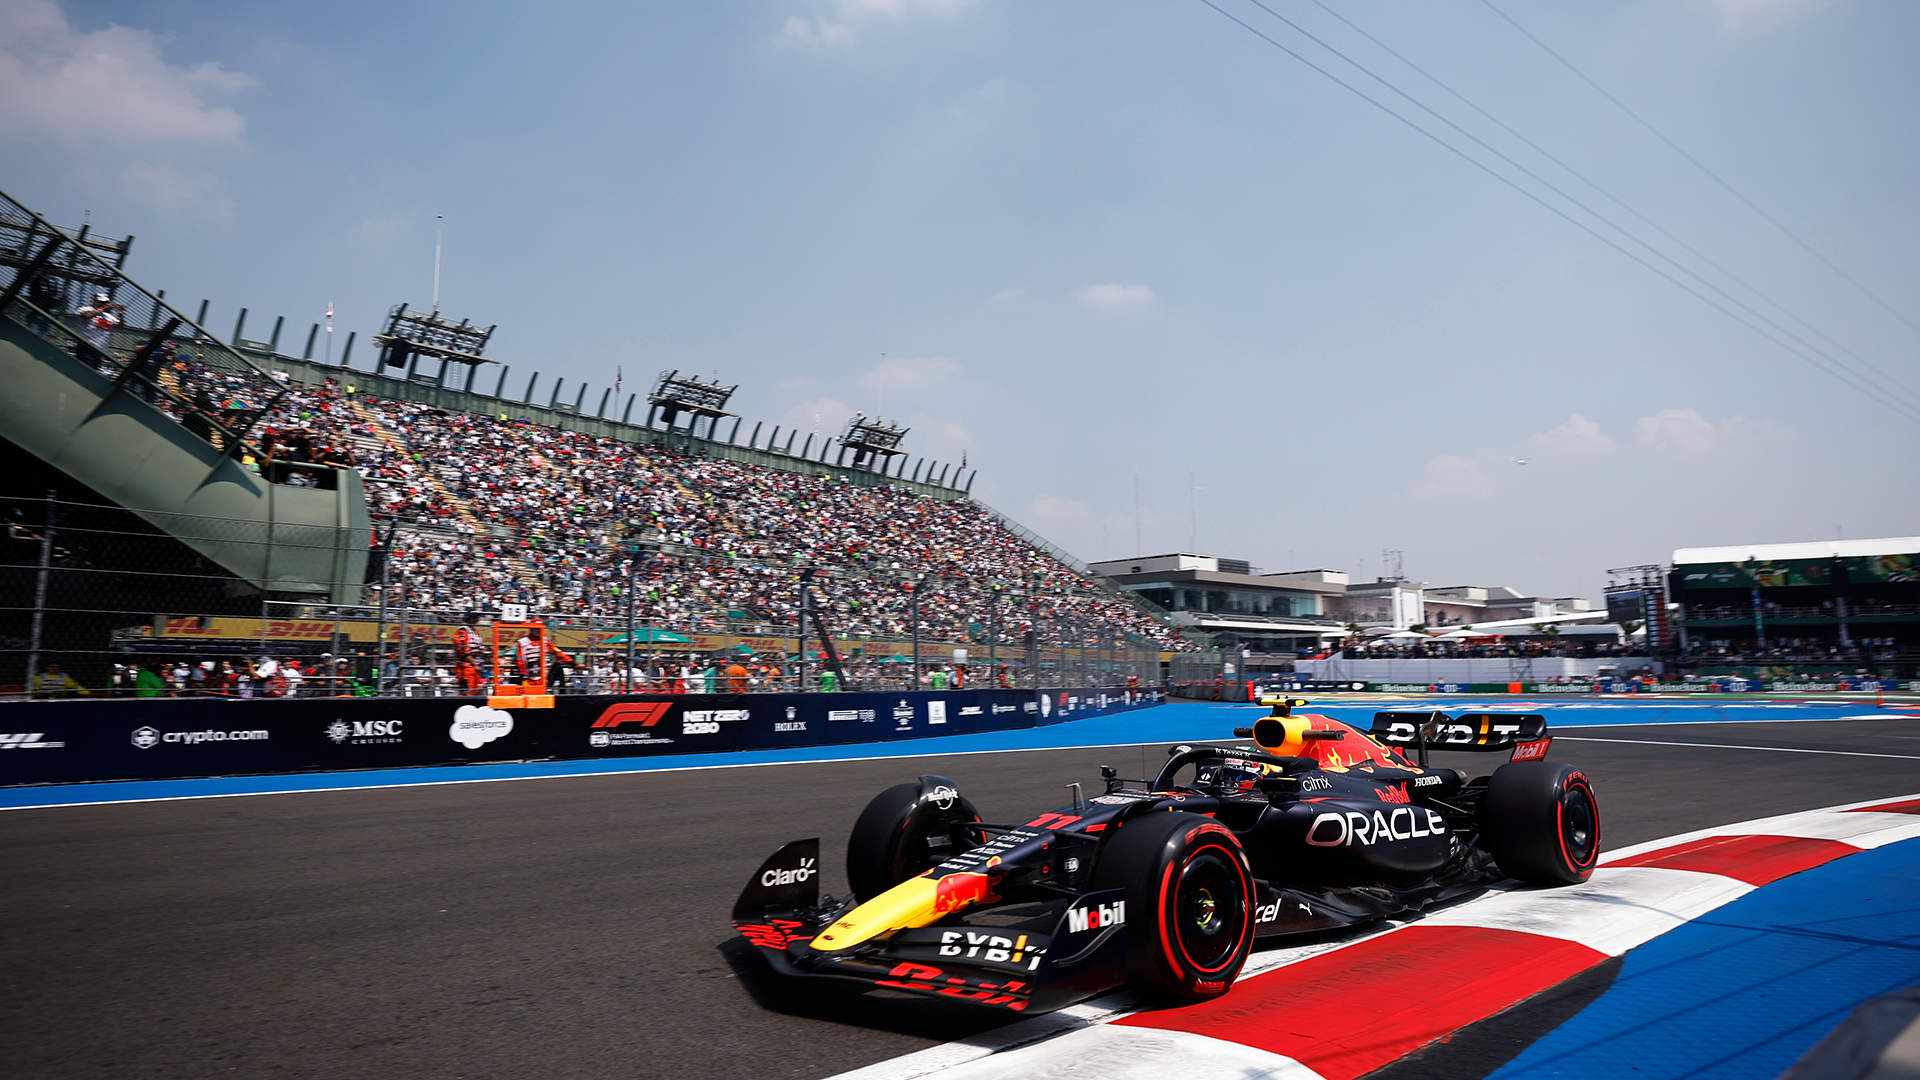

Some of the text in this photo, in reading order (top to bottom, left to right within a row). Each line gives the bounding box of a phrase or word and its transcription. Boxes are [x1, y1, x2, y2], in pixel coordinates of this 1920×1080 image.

[507, 606, 522, 617] 15
[264, 622, 335, 638] DHL
[1382, 683, 1428, 693] Heineken
[1538, 683, 1591, 693] Heineken
[1650, 683, 1707, 692] Heineken
[1772, 681, 1836, 691] Heineken
[682, 711, 712, 722] NET
[352, 720, 403, 736] MSC
[682, 722, 720, 735] 2030
[774, 722, 807, 732] ROLEX
[162, 729, 269, 744] crypto.com
[1512, 744, 1537, 760] Mobil
[1302, 775, 1333, 792] citrix
[1414, 775, 1443, 787] HONDA
[1567, 771, 1588, 783] ZERO
[1025, 812, 1084, 830] 11
[1305, 807, 1446, 847] ORACLE
[761, 864, 813, 887] Claro
[1068, 900, 1125, 933] Mobil
[1255, 898, 1282, 924] cel
